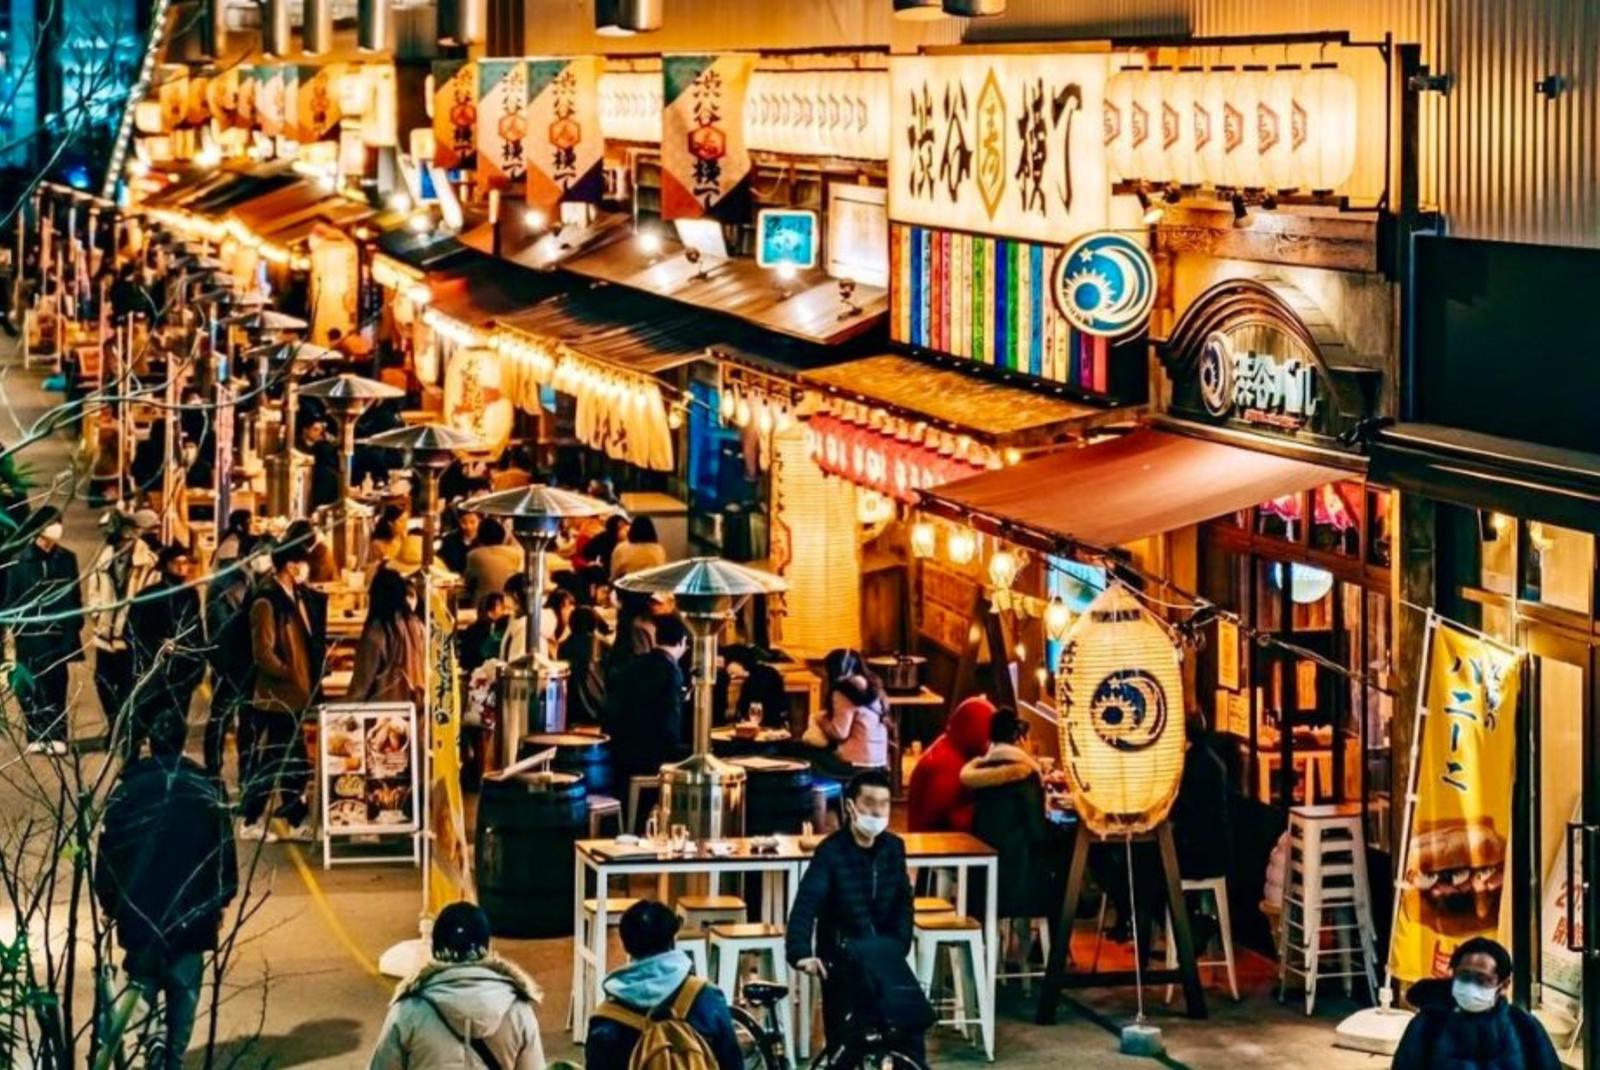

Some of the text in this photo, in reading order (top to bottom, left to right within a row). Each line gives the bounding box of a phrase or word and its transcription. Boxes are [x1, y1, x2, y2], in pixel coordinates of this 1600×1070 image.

[692, 69, 722, 128] 渋谷
[908, 78, 973, 203] 渋谷
[1014, 77, 1083, 216] 横丁
